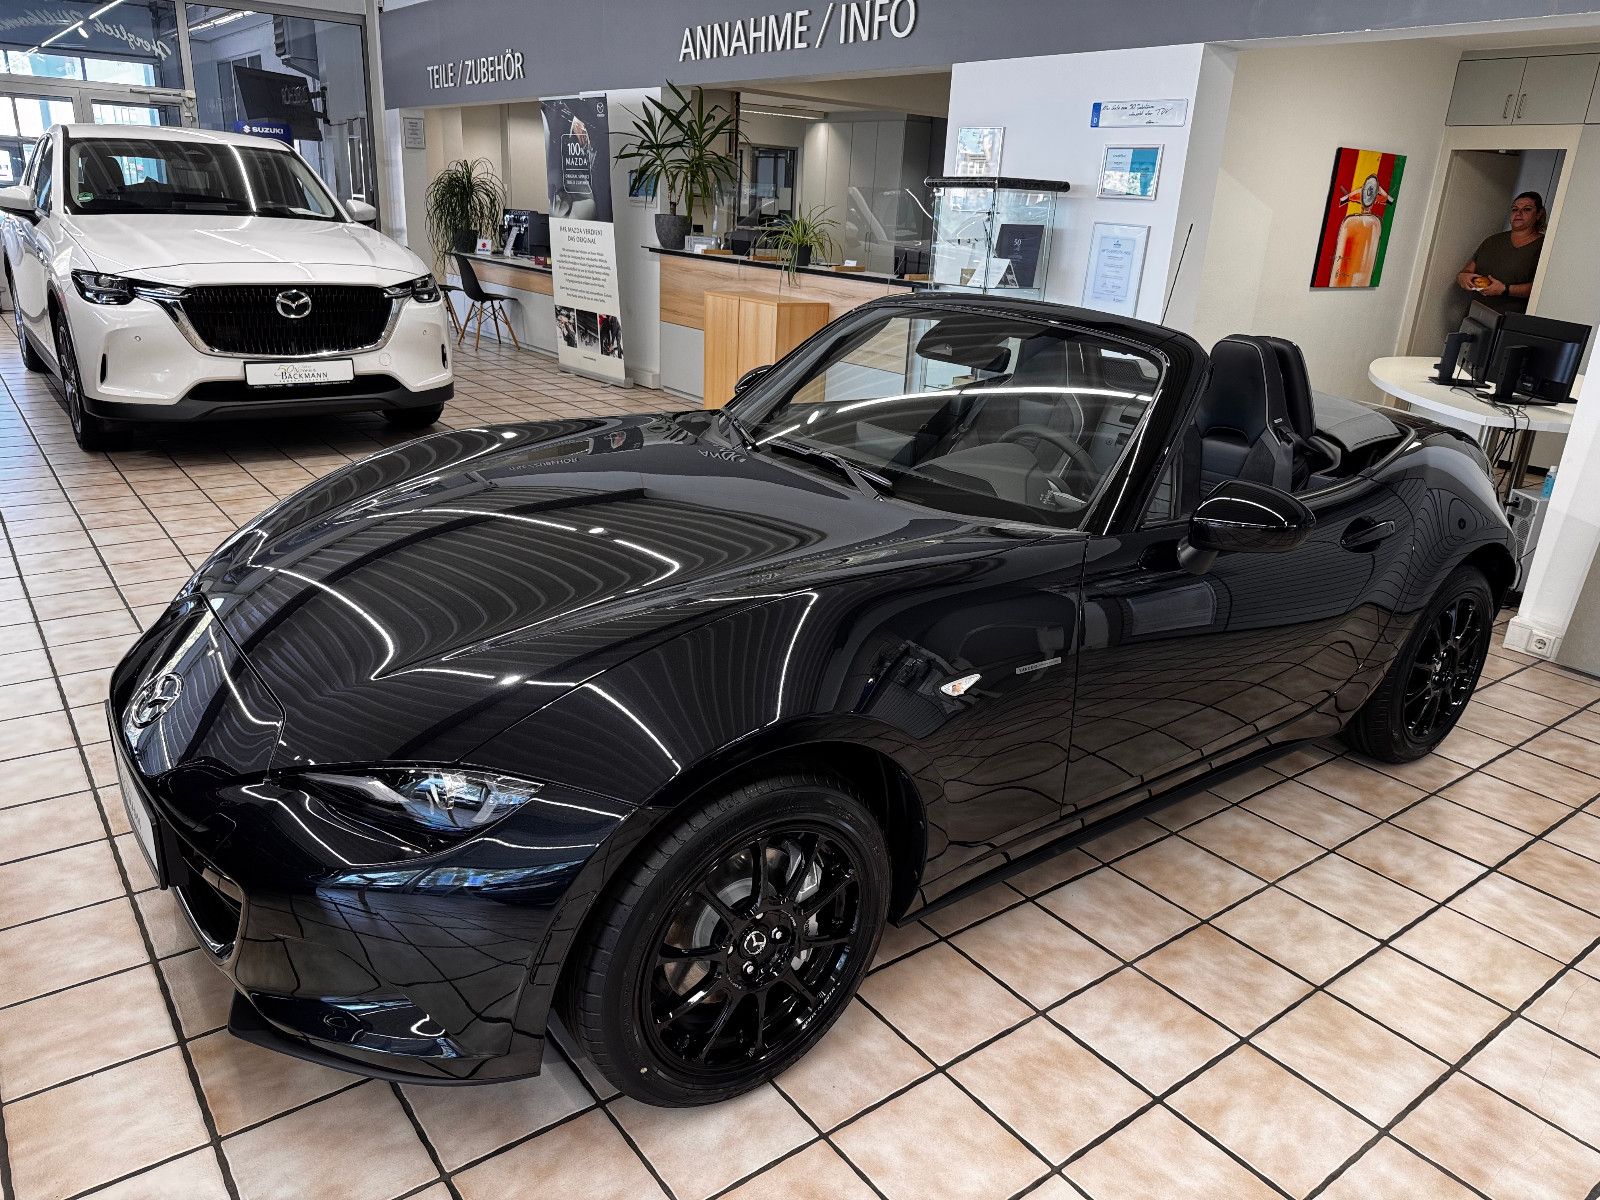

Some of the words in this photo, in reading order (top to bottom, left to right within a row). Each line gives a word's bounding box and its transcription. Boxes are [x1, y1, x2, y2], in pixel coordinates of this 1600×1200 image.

[679, 10, 810, 62] ANNAHME
[839, 0, 917, 44] INFO
[252, 126, 284, 135] SUZUKI
[566, 157, 588, 166] MAZDA
[281, 371, 328, 380] BACKMANN
